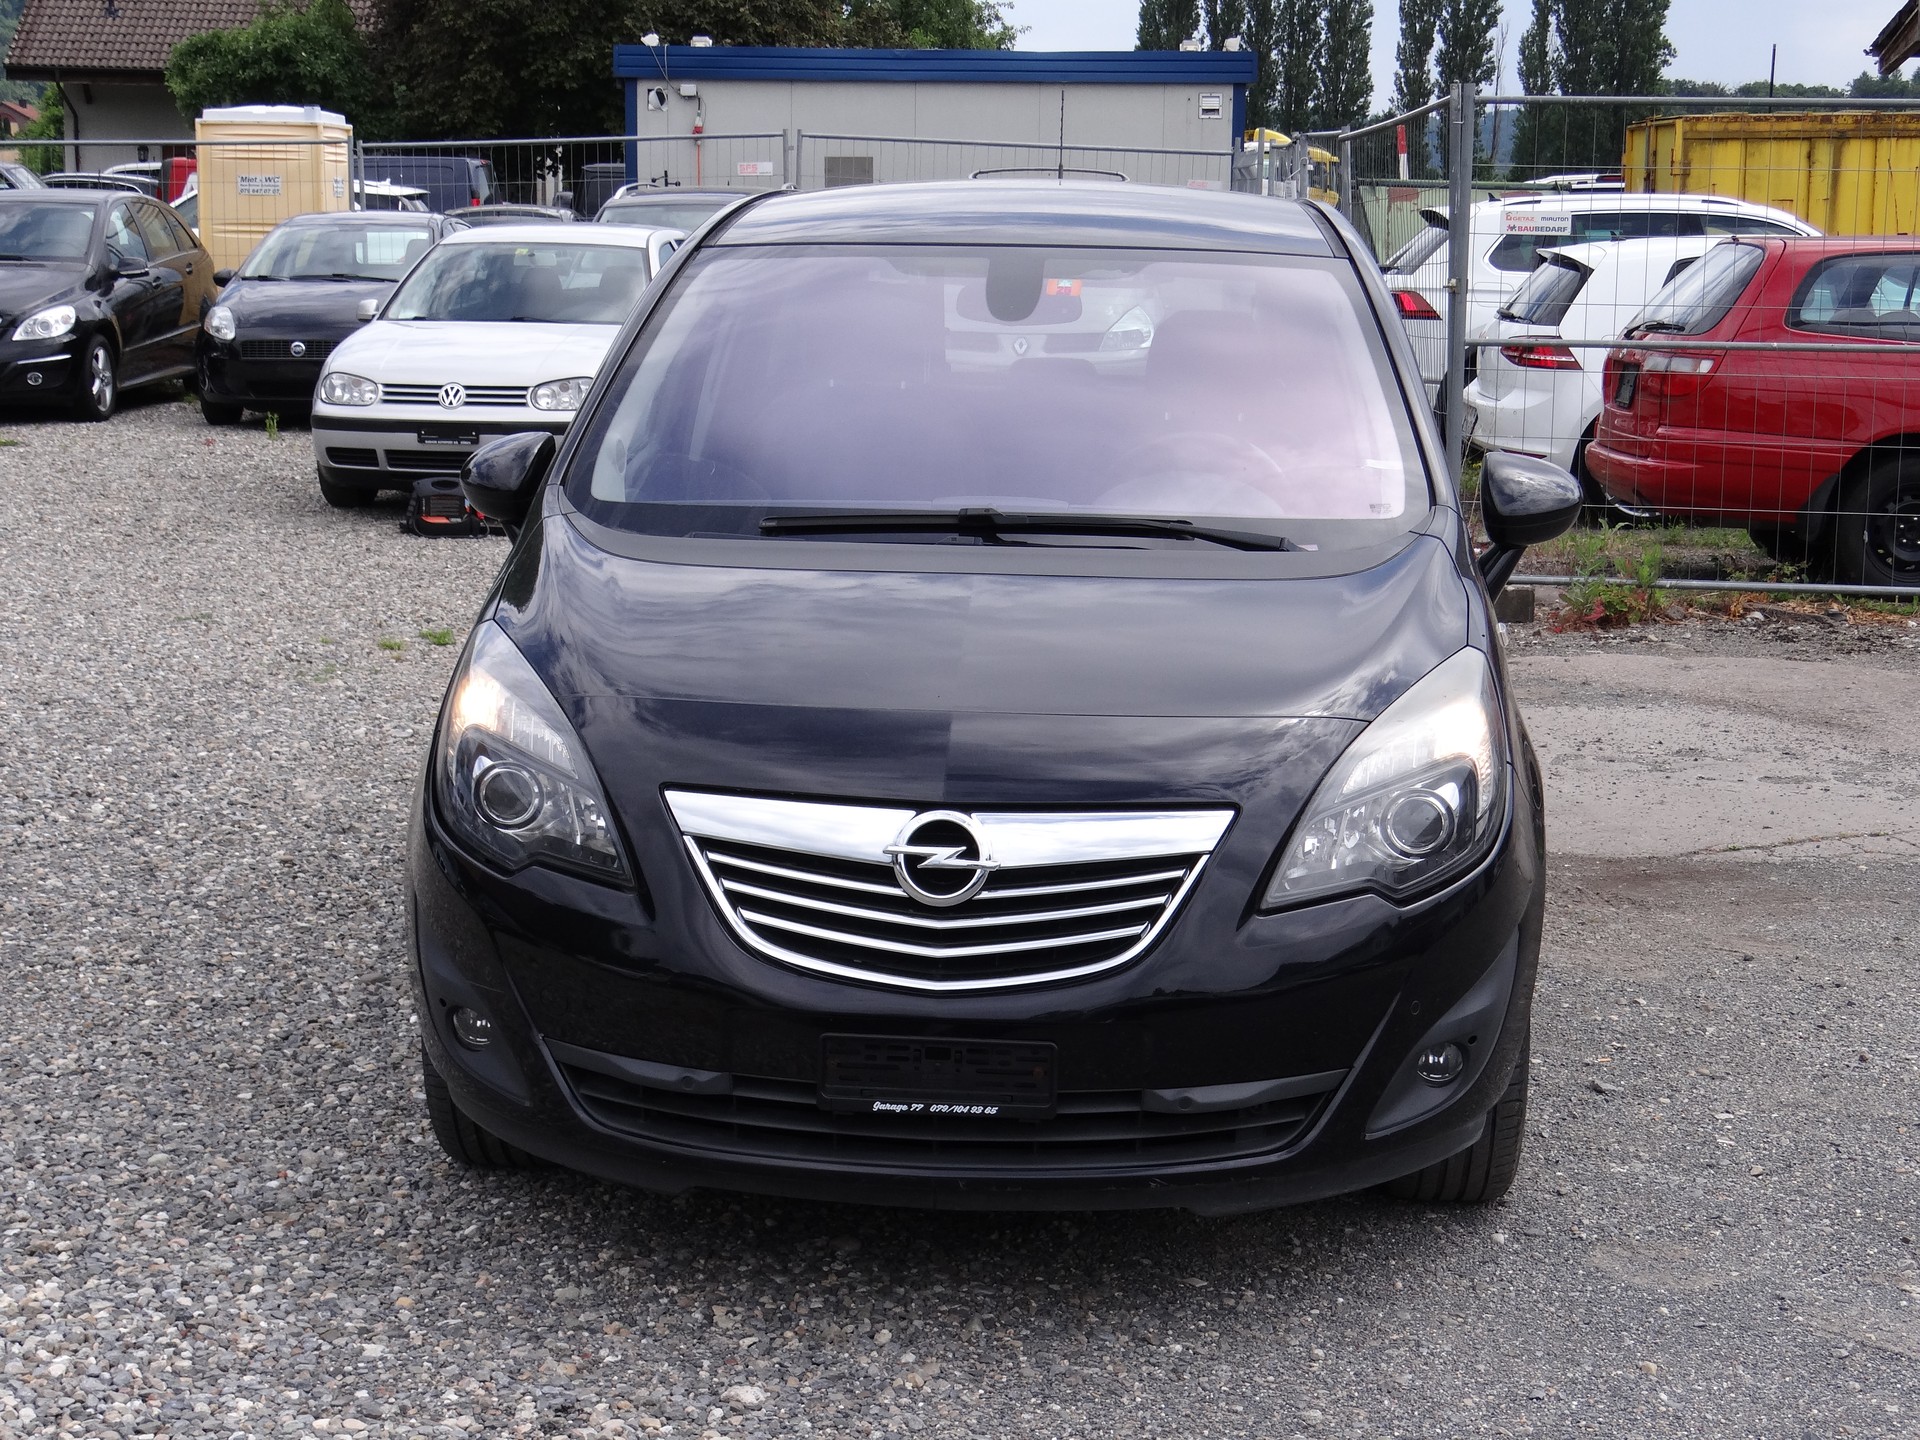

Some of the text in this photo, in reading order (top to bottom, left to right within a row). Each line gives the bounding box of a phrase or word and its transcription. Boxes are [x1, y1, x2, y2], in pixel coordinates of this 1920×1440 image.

[1517, 225, 1568, 233] BAUBEDARF
[872, 1101, 909, 1112] Garage
[929, 1104, 969, 1113] 079/104
